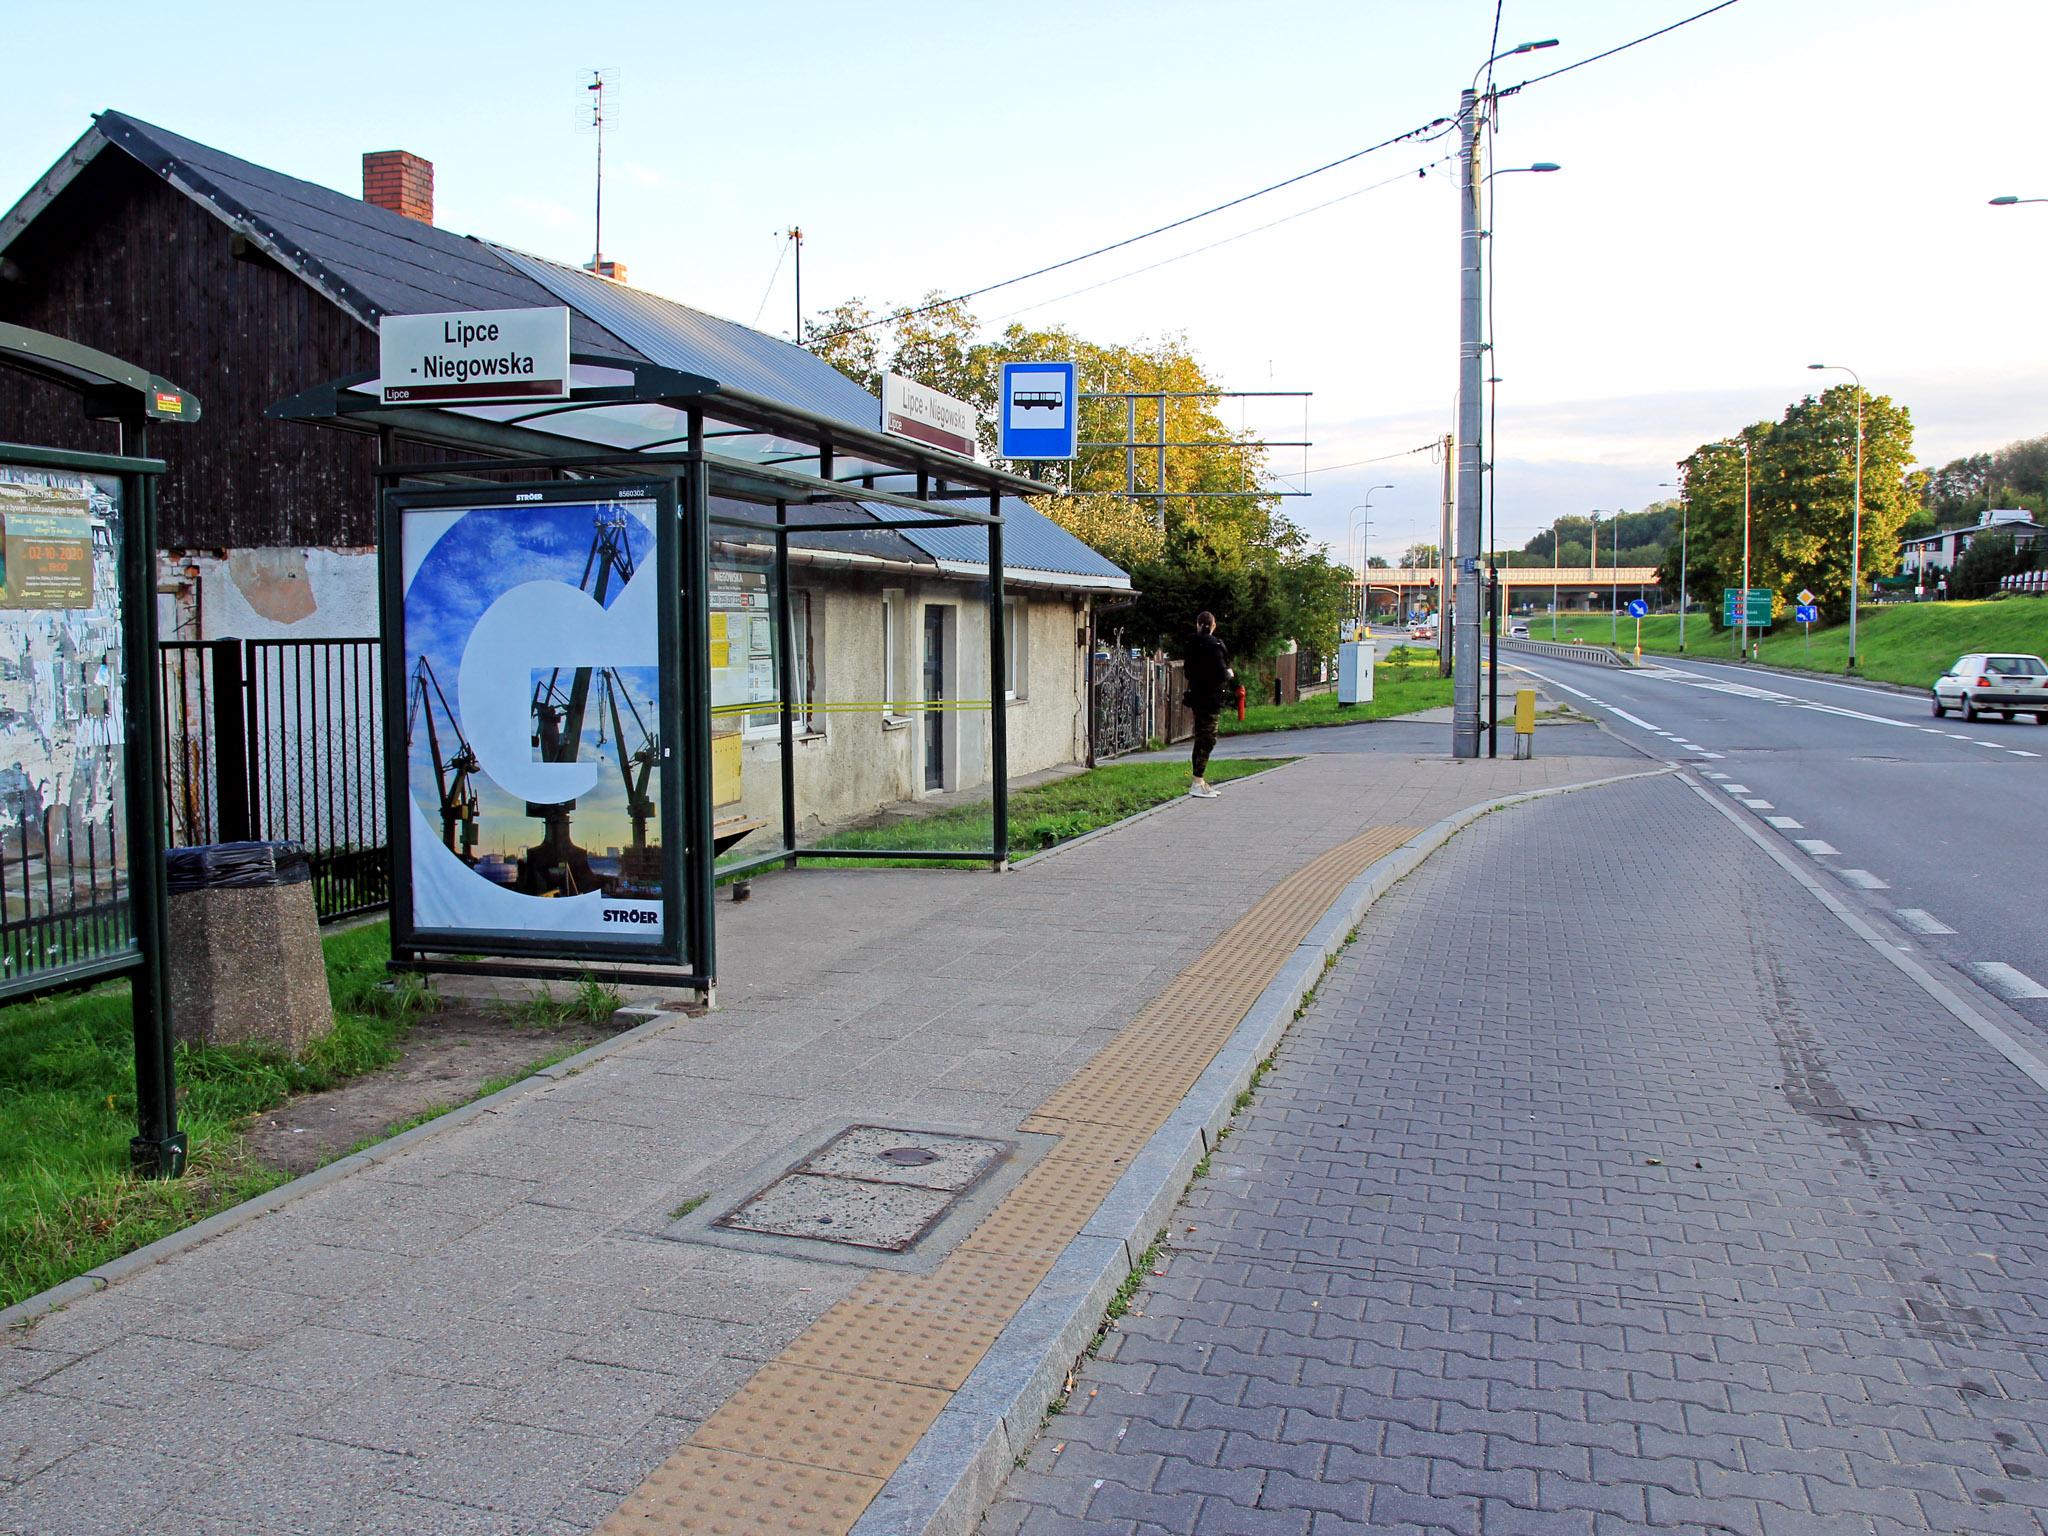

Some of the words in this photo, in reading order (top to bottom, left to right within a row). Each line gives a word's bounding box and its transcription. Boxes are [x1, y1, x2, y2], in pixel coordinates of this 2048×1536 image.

[444, 320, 499, 348] Lipce
[424, 352, 534, 382] Niegowska
[386, 389, 410, 400] Lipce
[903, 386, 924, 416] Lipce
[929, 397, 966, 430] Niegowska
[889, 415, 903, 432] Lipce
[515, 493, 544, 501] STRÖER
[618, 489, 645, 498] 8560302
[714, 571, 744, 583] NIEGOWSKA
[603, 909, 658, 924] STRÖER
